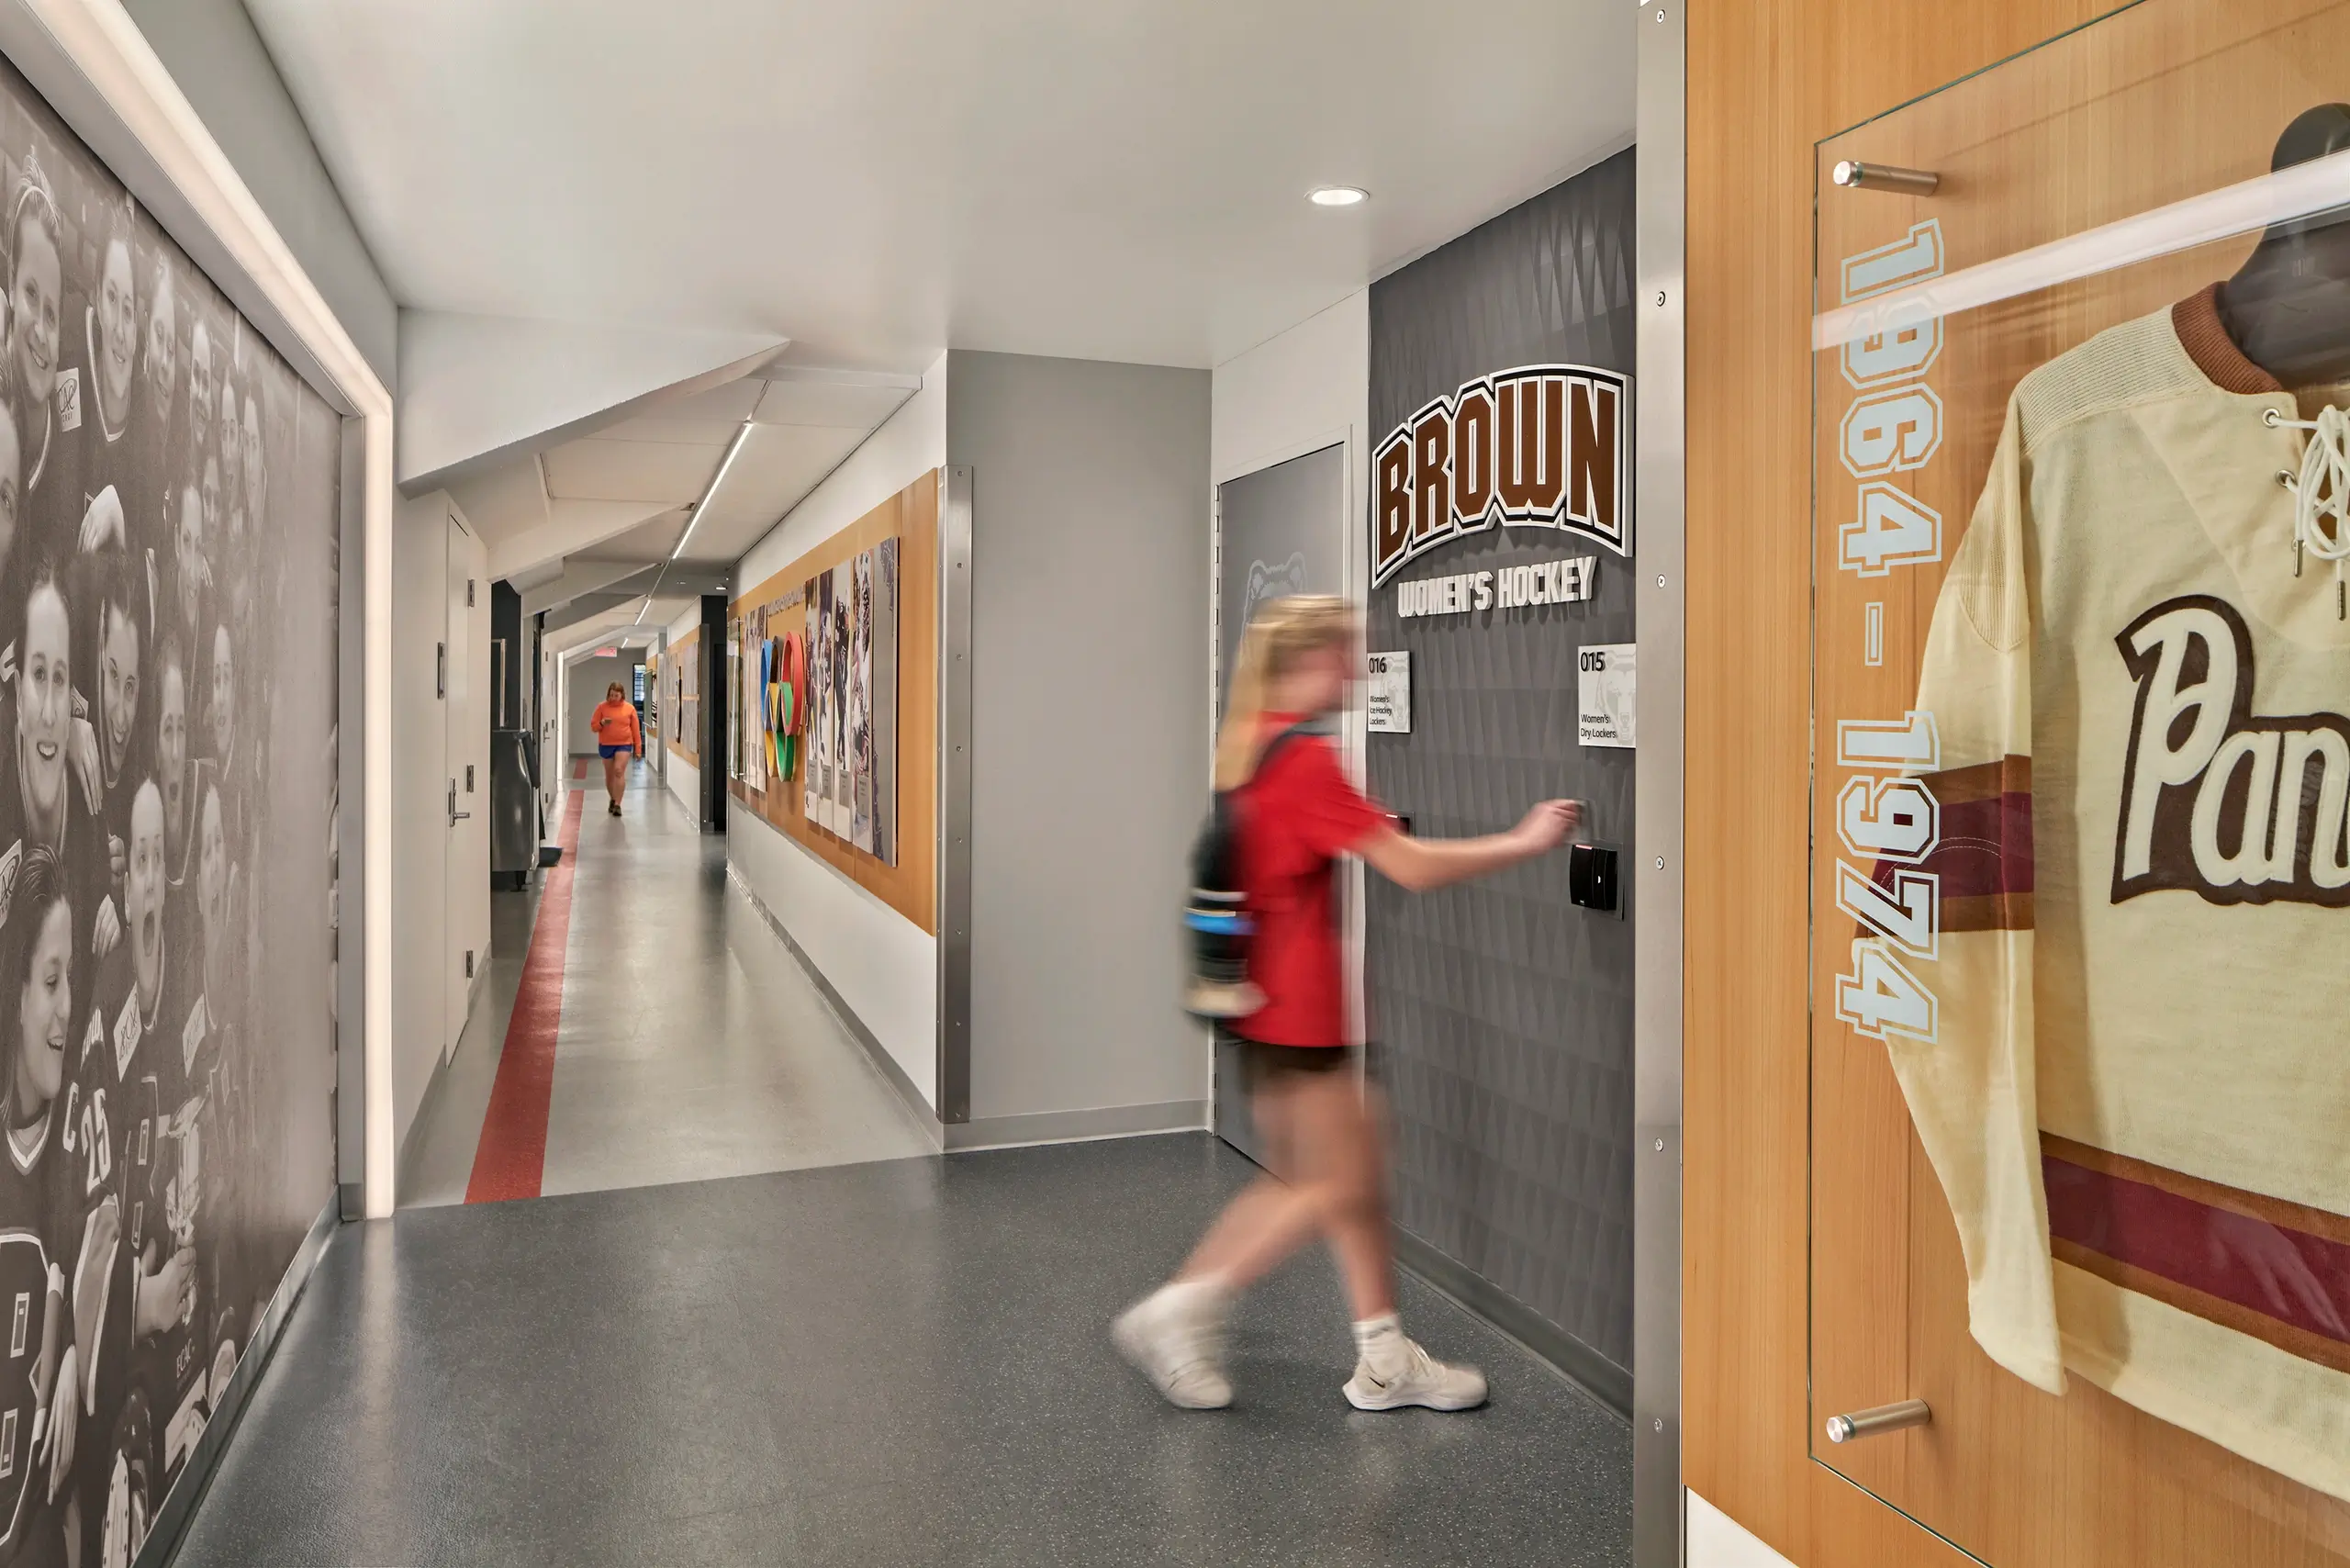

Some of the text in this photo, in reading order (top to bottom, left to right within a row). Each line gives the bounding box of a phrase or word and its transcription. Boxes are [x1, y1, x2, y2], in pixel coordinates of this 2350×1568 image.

[1839, 218, 1944, 577] 1964
[1373, 364, 1630, 588] BROWN
[1398, 556, 1597, 618] WOMEN'S HOCKEY
[1369, 656, 1387, 674] 016
[1580, 651, 1606, 672] 015
[1370, 695, 1390, 703] Women's
[1377, 706, 1392, 716] Hockey
[1581, 714, 1609, 723] Women's
[1581, 728, 1617, 740] Dry Lockers
[1836, 711, 1940, 1044] 1974
